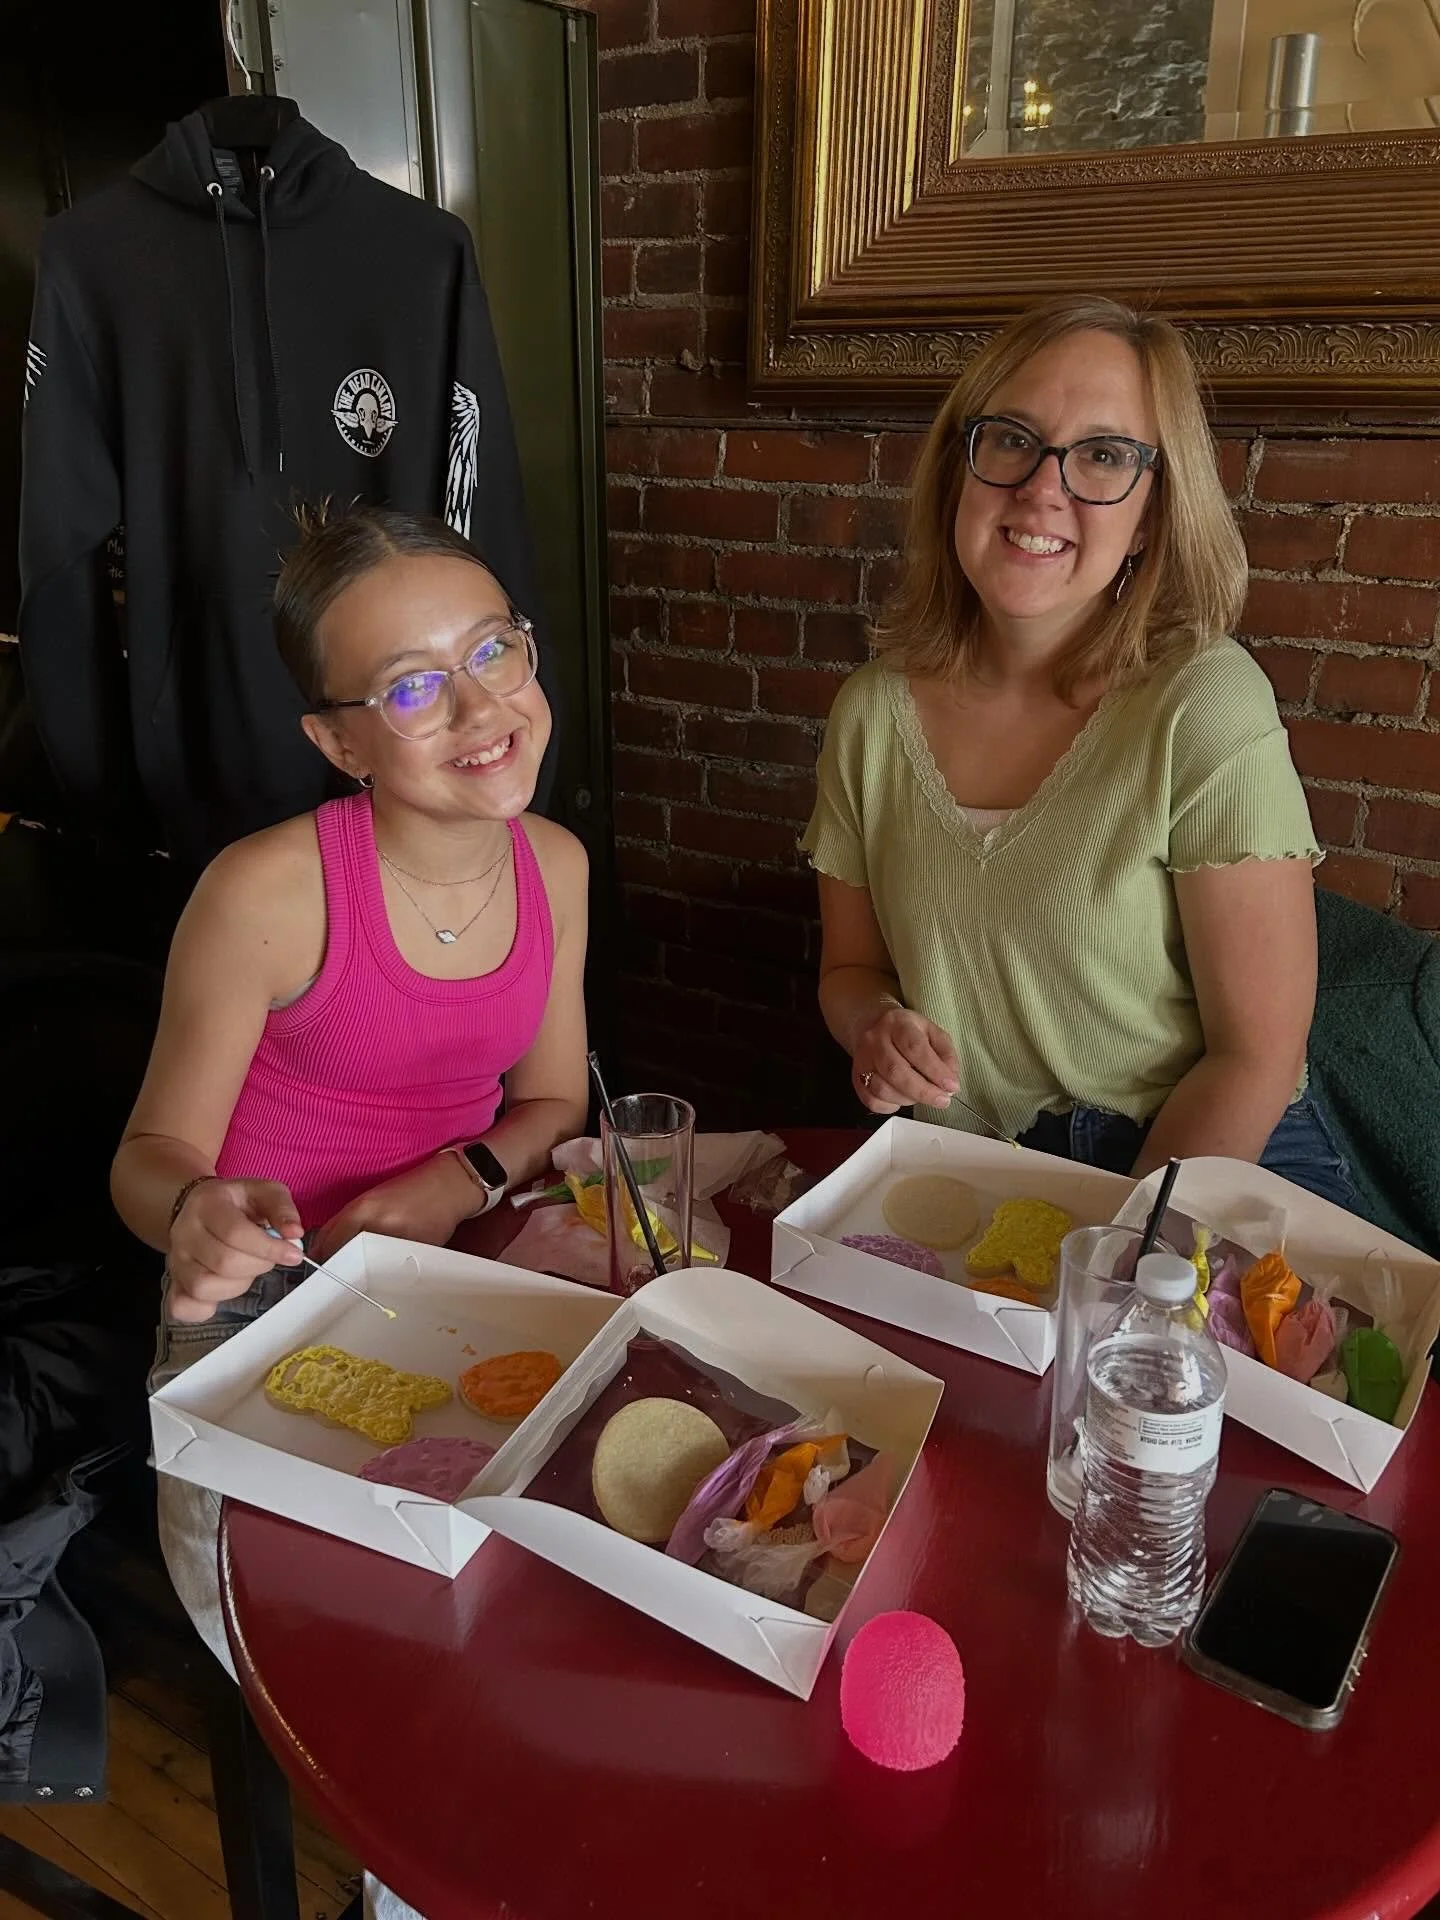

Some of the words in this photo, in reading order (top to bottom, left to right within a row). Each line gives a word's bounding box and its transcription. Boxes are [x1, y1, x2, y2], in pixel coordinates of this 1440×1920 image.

[338, 388, 355, 410] THE
[348, 373, 370, 395] DEAD
[371, 375, 392, 419] CANARY
